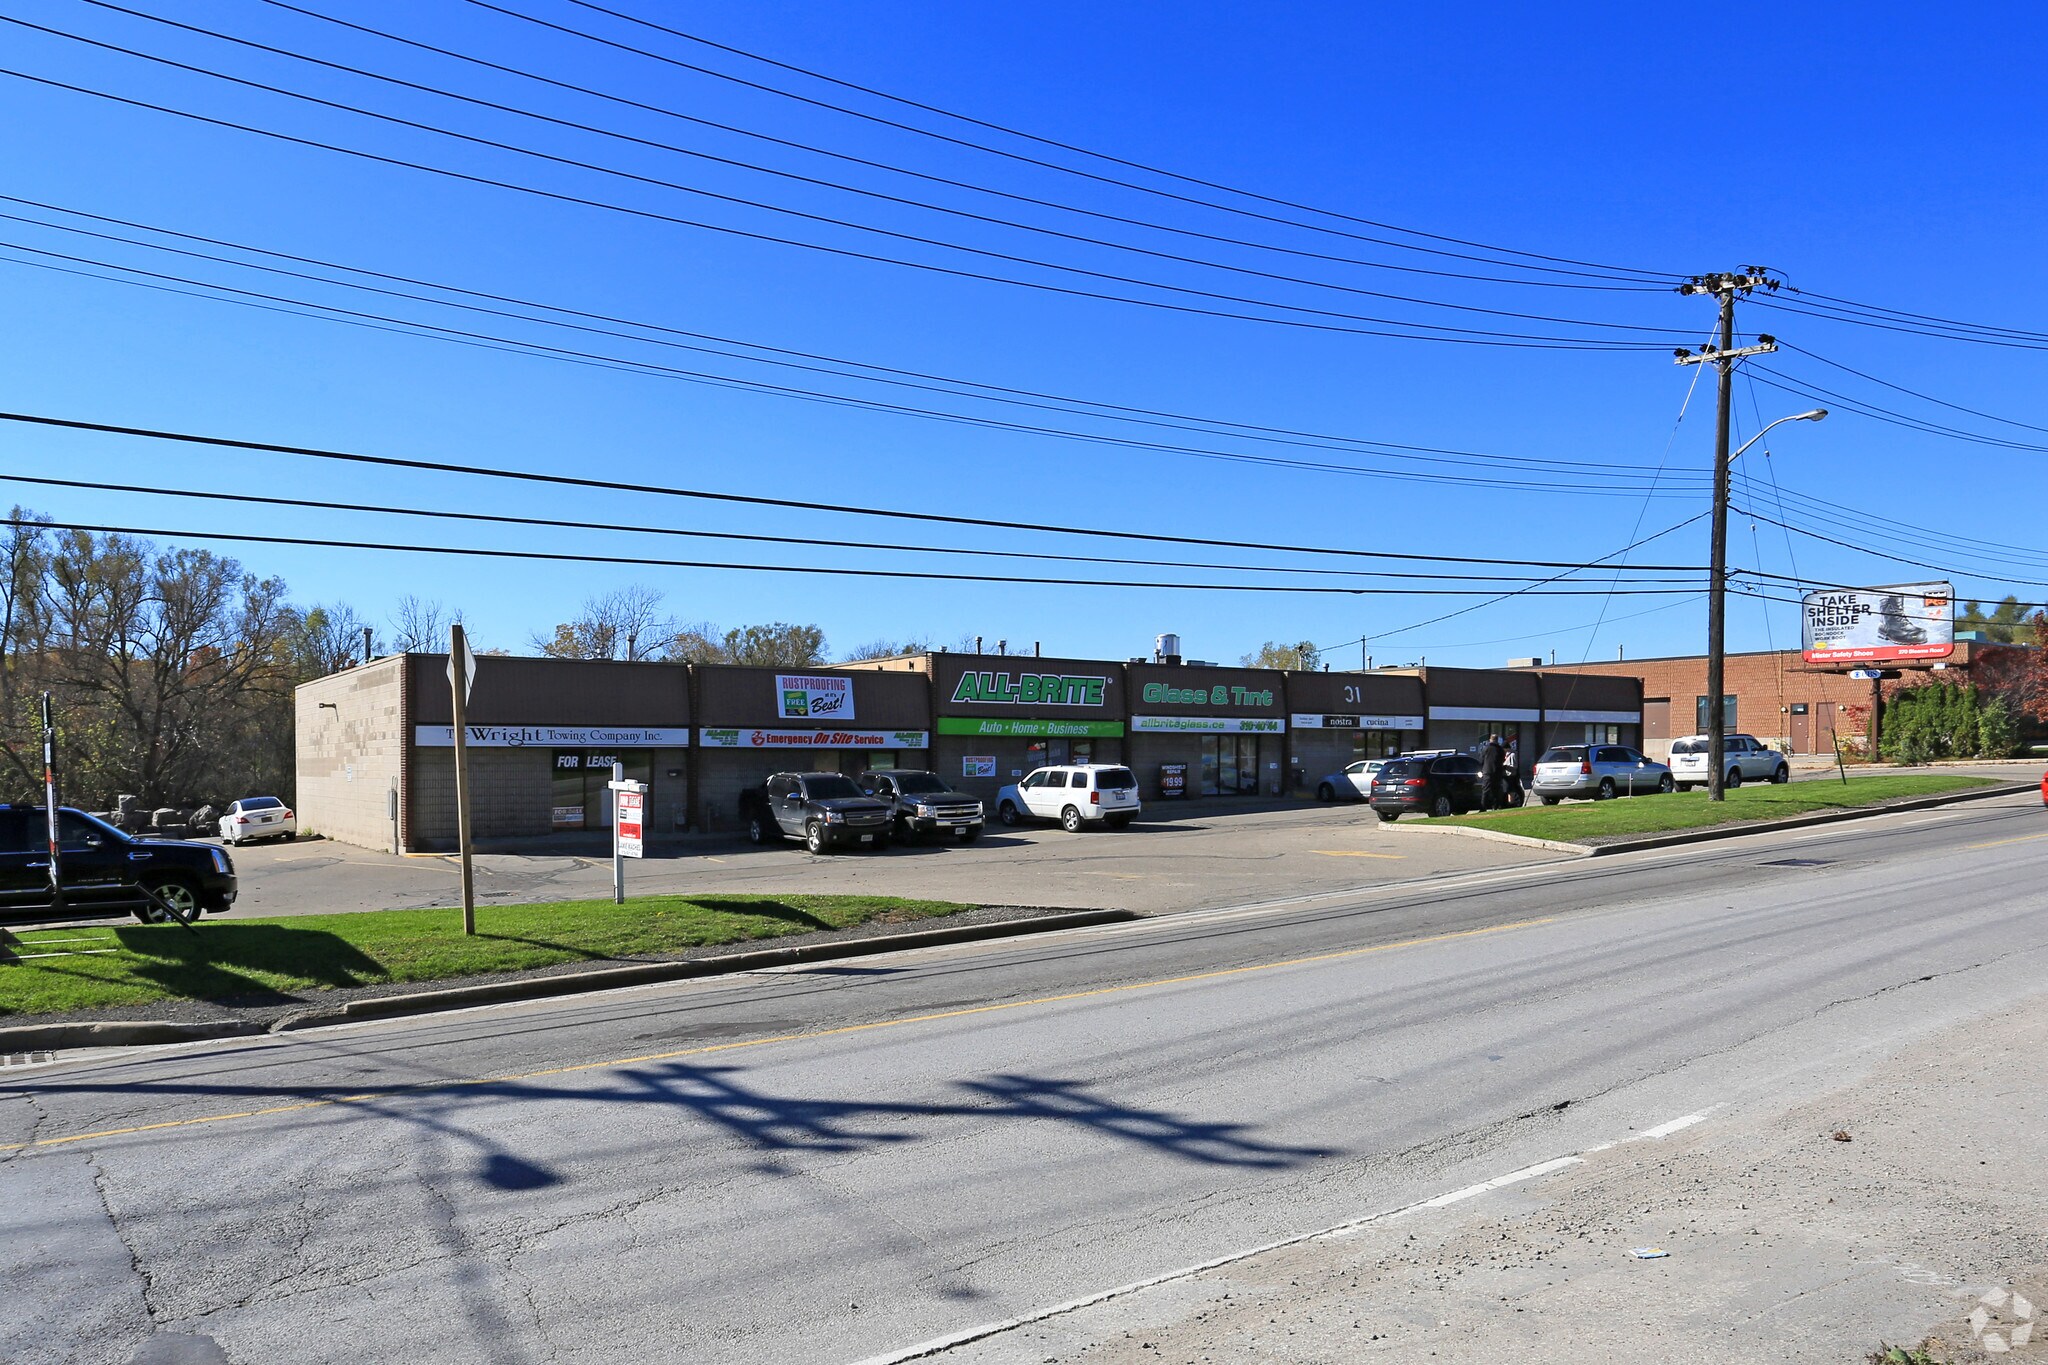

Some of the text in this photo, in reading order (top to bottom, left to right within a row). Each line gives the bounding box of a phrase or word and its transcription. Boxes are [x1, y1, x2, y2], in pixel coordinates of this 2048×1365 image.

[1820, 595, 1856, 606] TAKE
[1812, 615, 1859, 627] INSIDE
[783, 678, 846, 690] RUSTPROOFING
[952, 671, 1106, 706] ALL-BRITE
[1143, 683, 1273, 706] Glass & Tint
[1344, 685, 1361, 703] 31
[811, 693, 845, 713] Best!
[979, 721, 1088, 735] Auto Home Business
[1330, 718, 1352, 726] nostra
[1366, 718, 1389, 726] cucina
[469, 727, 544, 746] Wright
[547, 729, 587, 743] Towing
[590, 730, 640, 743] Company
[644, 731, 662, 740] Inc.
[767, 732, 883, 744] Emergency On Site Service
[557, 756, 617, 767] FOR LEASE
